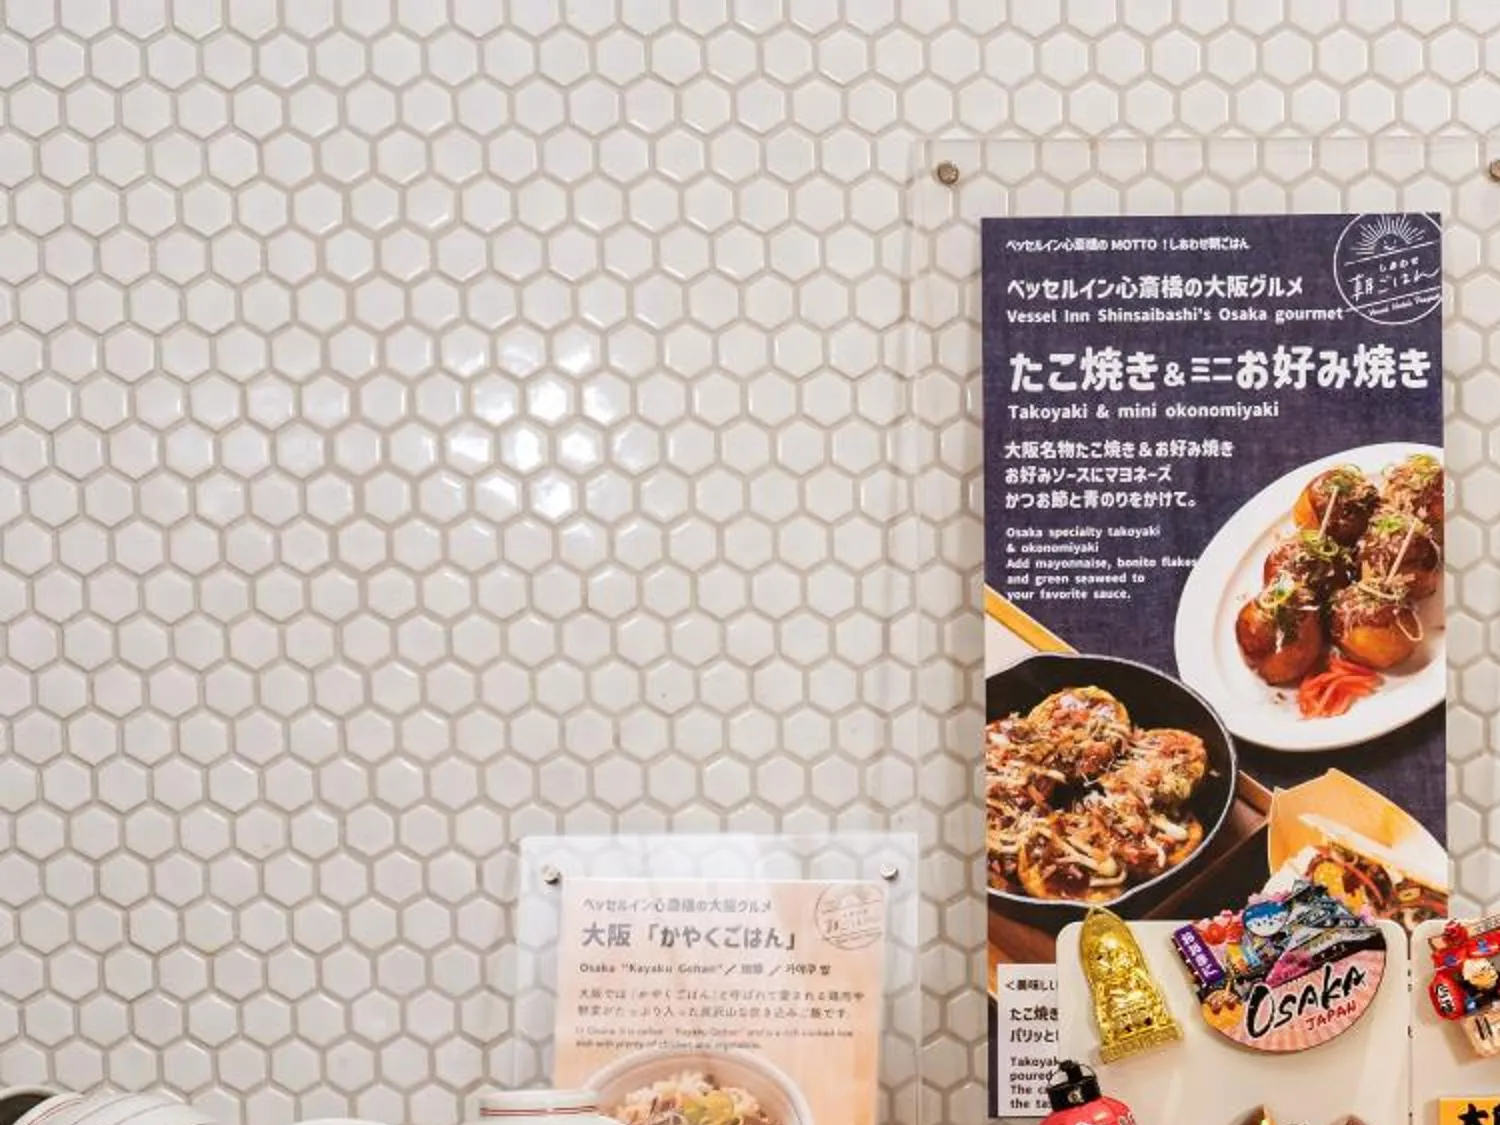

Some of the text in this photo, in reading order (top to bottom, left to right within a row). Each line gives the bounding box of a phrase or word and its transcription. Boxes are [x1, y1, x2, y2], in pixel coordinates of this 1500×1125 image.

[1111, 238, 1157, 250] MOTTO
[1007, 274, 1303, 299] ベッセルイン心斎橋の大阪グルメ
[1007, 307, 1344, 325] Vessel Inn Shinsaibashi's Osaka gourmet
[1008, 401, 1279, 421] Takoyaki & mini okonomiyaki
[1005, 465, 1172, 485] お好みソースにマヨネーズ
[1005, 489, 1197, 509] かつお節と青のりをかけて。
[1006, 525, 1161, 541] Osaka specialty takoyaki
[1006, 541, 1099, 556] & okonomiyaki
[1006, 555, 1198, 572] Add mayonnaise, bonito flakes
[1007, 572, 1145, 587] and green seaweed to
[1007, 587, 1131, 601] your favorite sauce.
[581, 923, 796, 949] 大阪「かやくごはん」
[1009, 1004, 1058, 1021] たこ焼き
[1305, 1003, 1356, 1030] JAPAN
[1009, 1028, 1059, 1043] パリッと
[1010, 1056, 1060, 1068] Takoyak
[1011, 1085, 1032, 1095] The
[1010, 1098, 1031, 1109] the
